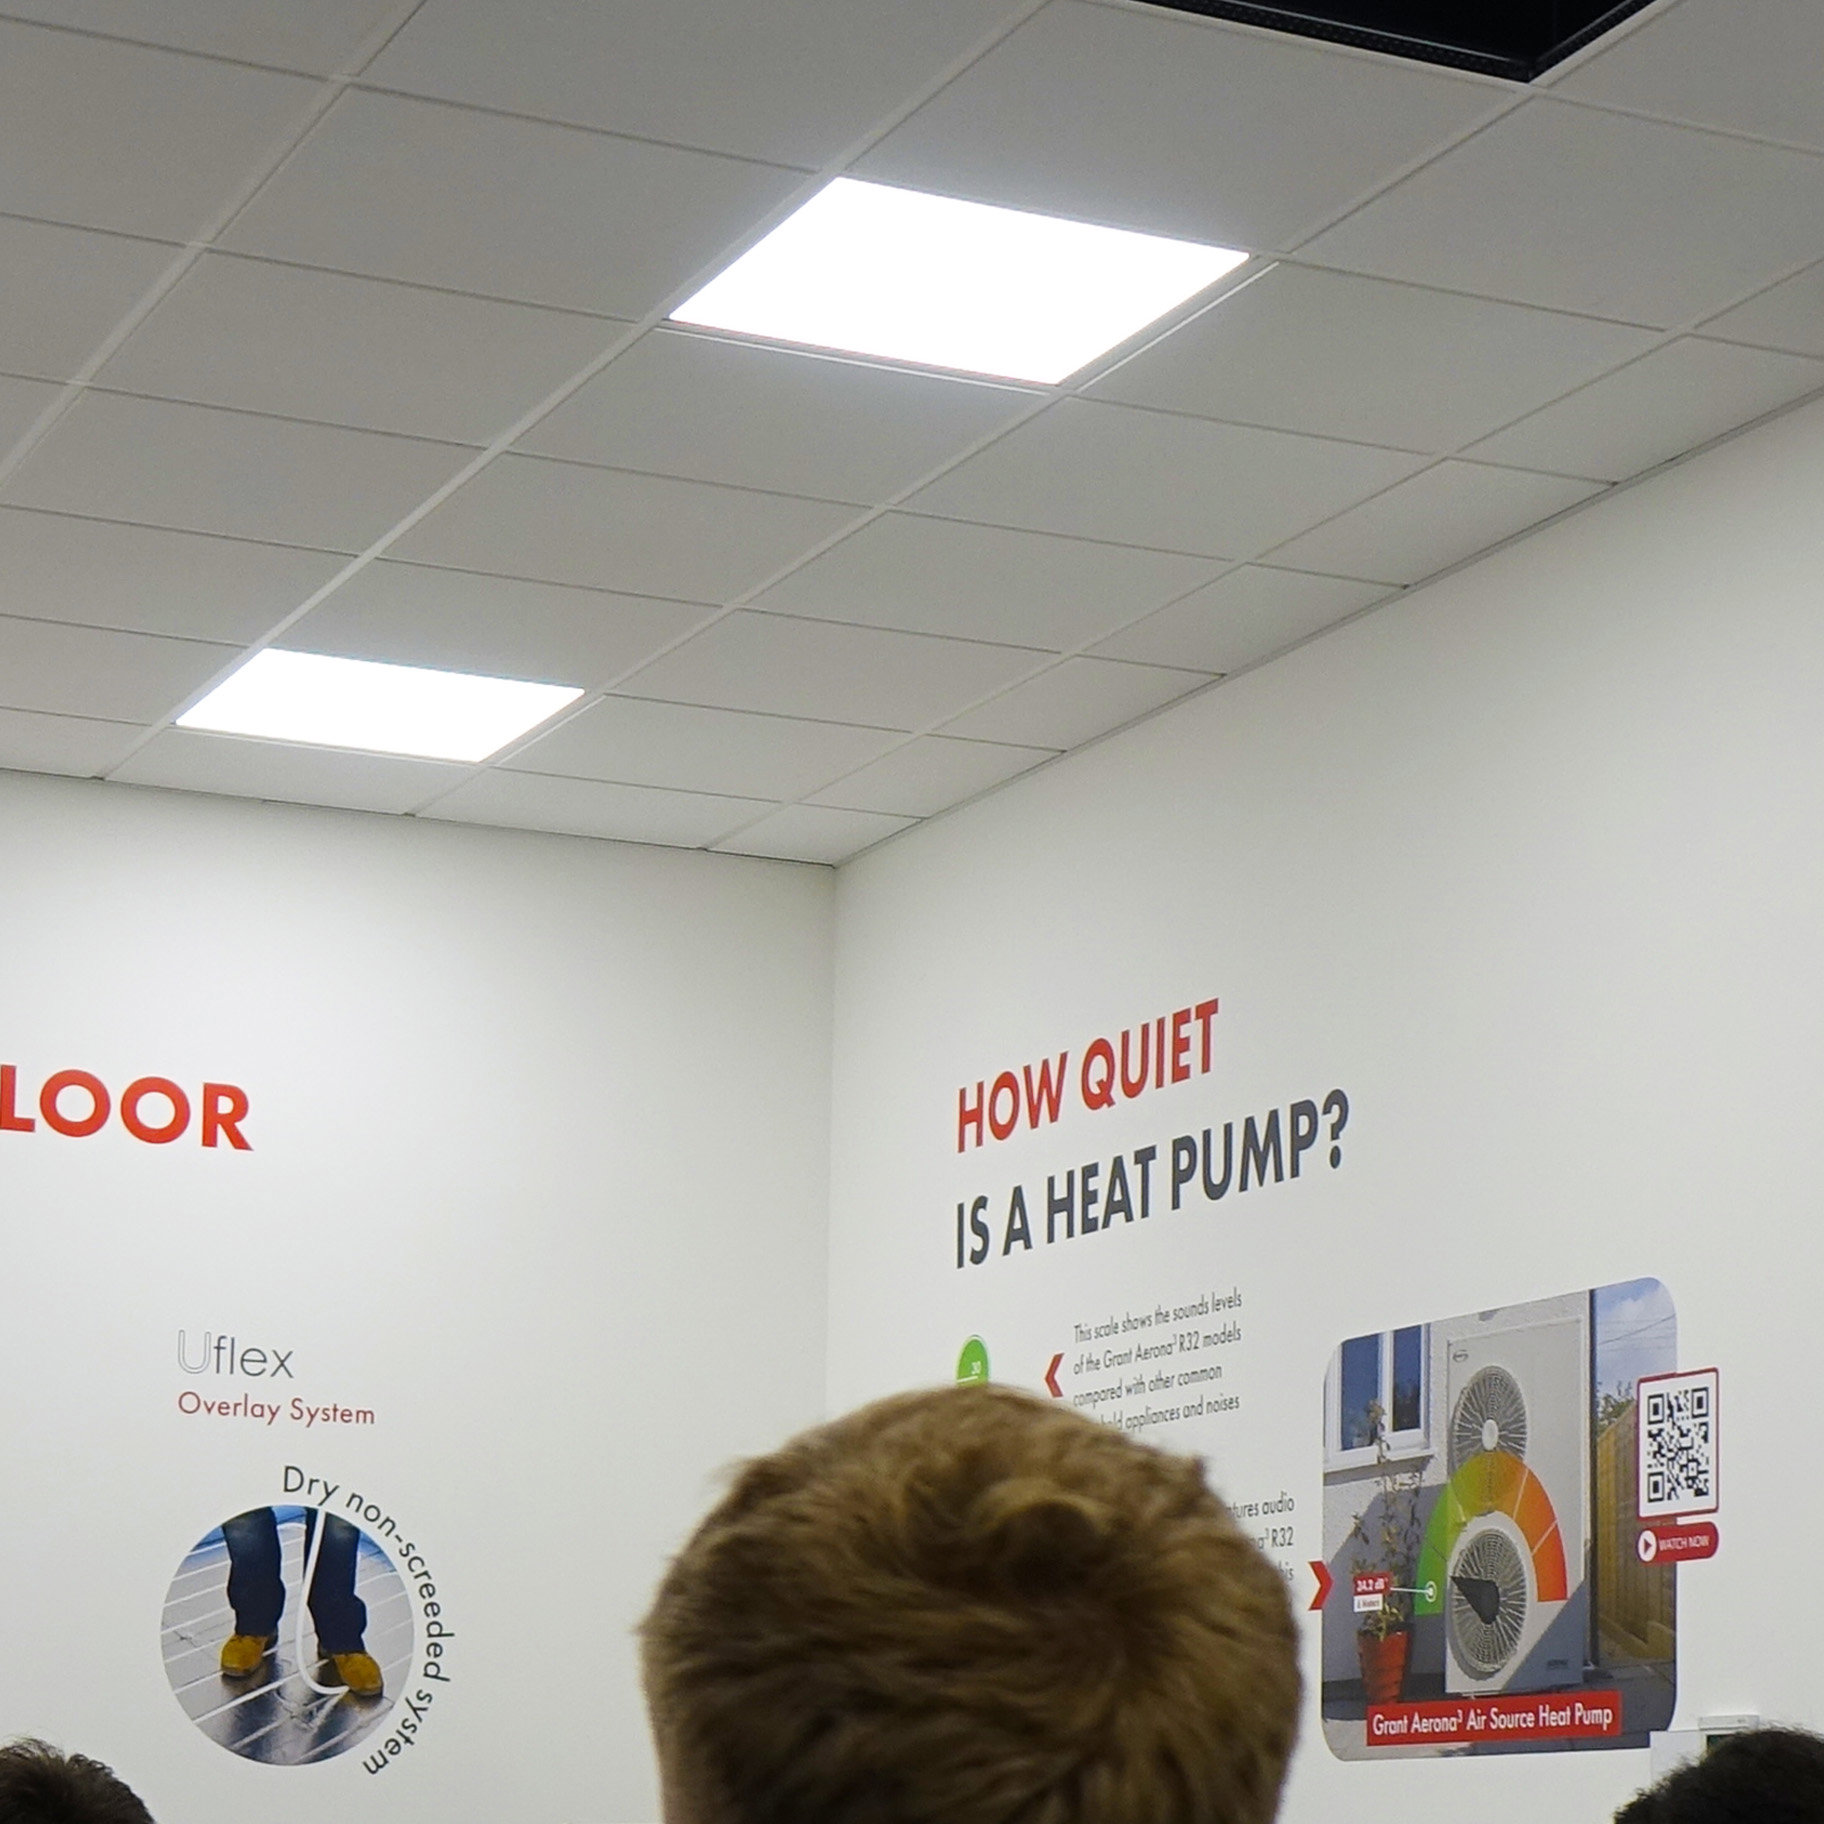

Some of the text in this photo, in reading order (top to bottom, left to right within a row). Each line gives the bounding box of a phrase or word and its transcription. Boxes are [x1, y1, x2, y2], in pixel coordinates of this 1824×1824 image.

[958, 997, 1219, 1153] HOW QUIET
[957, 1088, 1350, 1269] IS A HEAT PUMP?
[1074, 1286, 1242, 1344] This scale shows the sounds levels
[178, 1329, 294, 1379] Uflex
[1073, 1354, 1084, 1375] of
[1086, 1352, 1100, 1372] the
[1103, 1349, 1133, 1369] Grant
[1179, 1331, 1199, 1353] R32
[1203, 1321, 1242, 1346] models
[178, 1391, 375, 1428] Overlay System
[1073, 1365, 1222, 1409] compared with other common
[1125, 1405, 1180, 1433] appliances
[1182, 1394, 1204, 1417] and
[1206, 1393, 1240, 1416] noises
[1262, 1491, 1295, 1515] audio
[1271, 1526, 1294, 1547] R32
[282, 1466, 455, 1776] Dry non-screeded system
[1373, 1713, 1408, 1735] Grant
[1467, 1708, 1487, 1730] Air
[1490, 1707, 1535, 1730] Source
[1538, 1705, 1571, 1727] Heat
[1575, 1702, 1613, 1731] Pump
